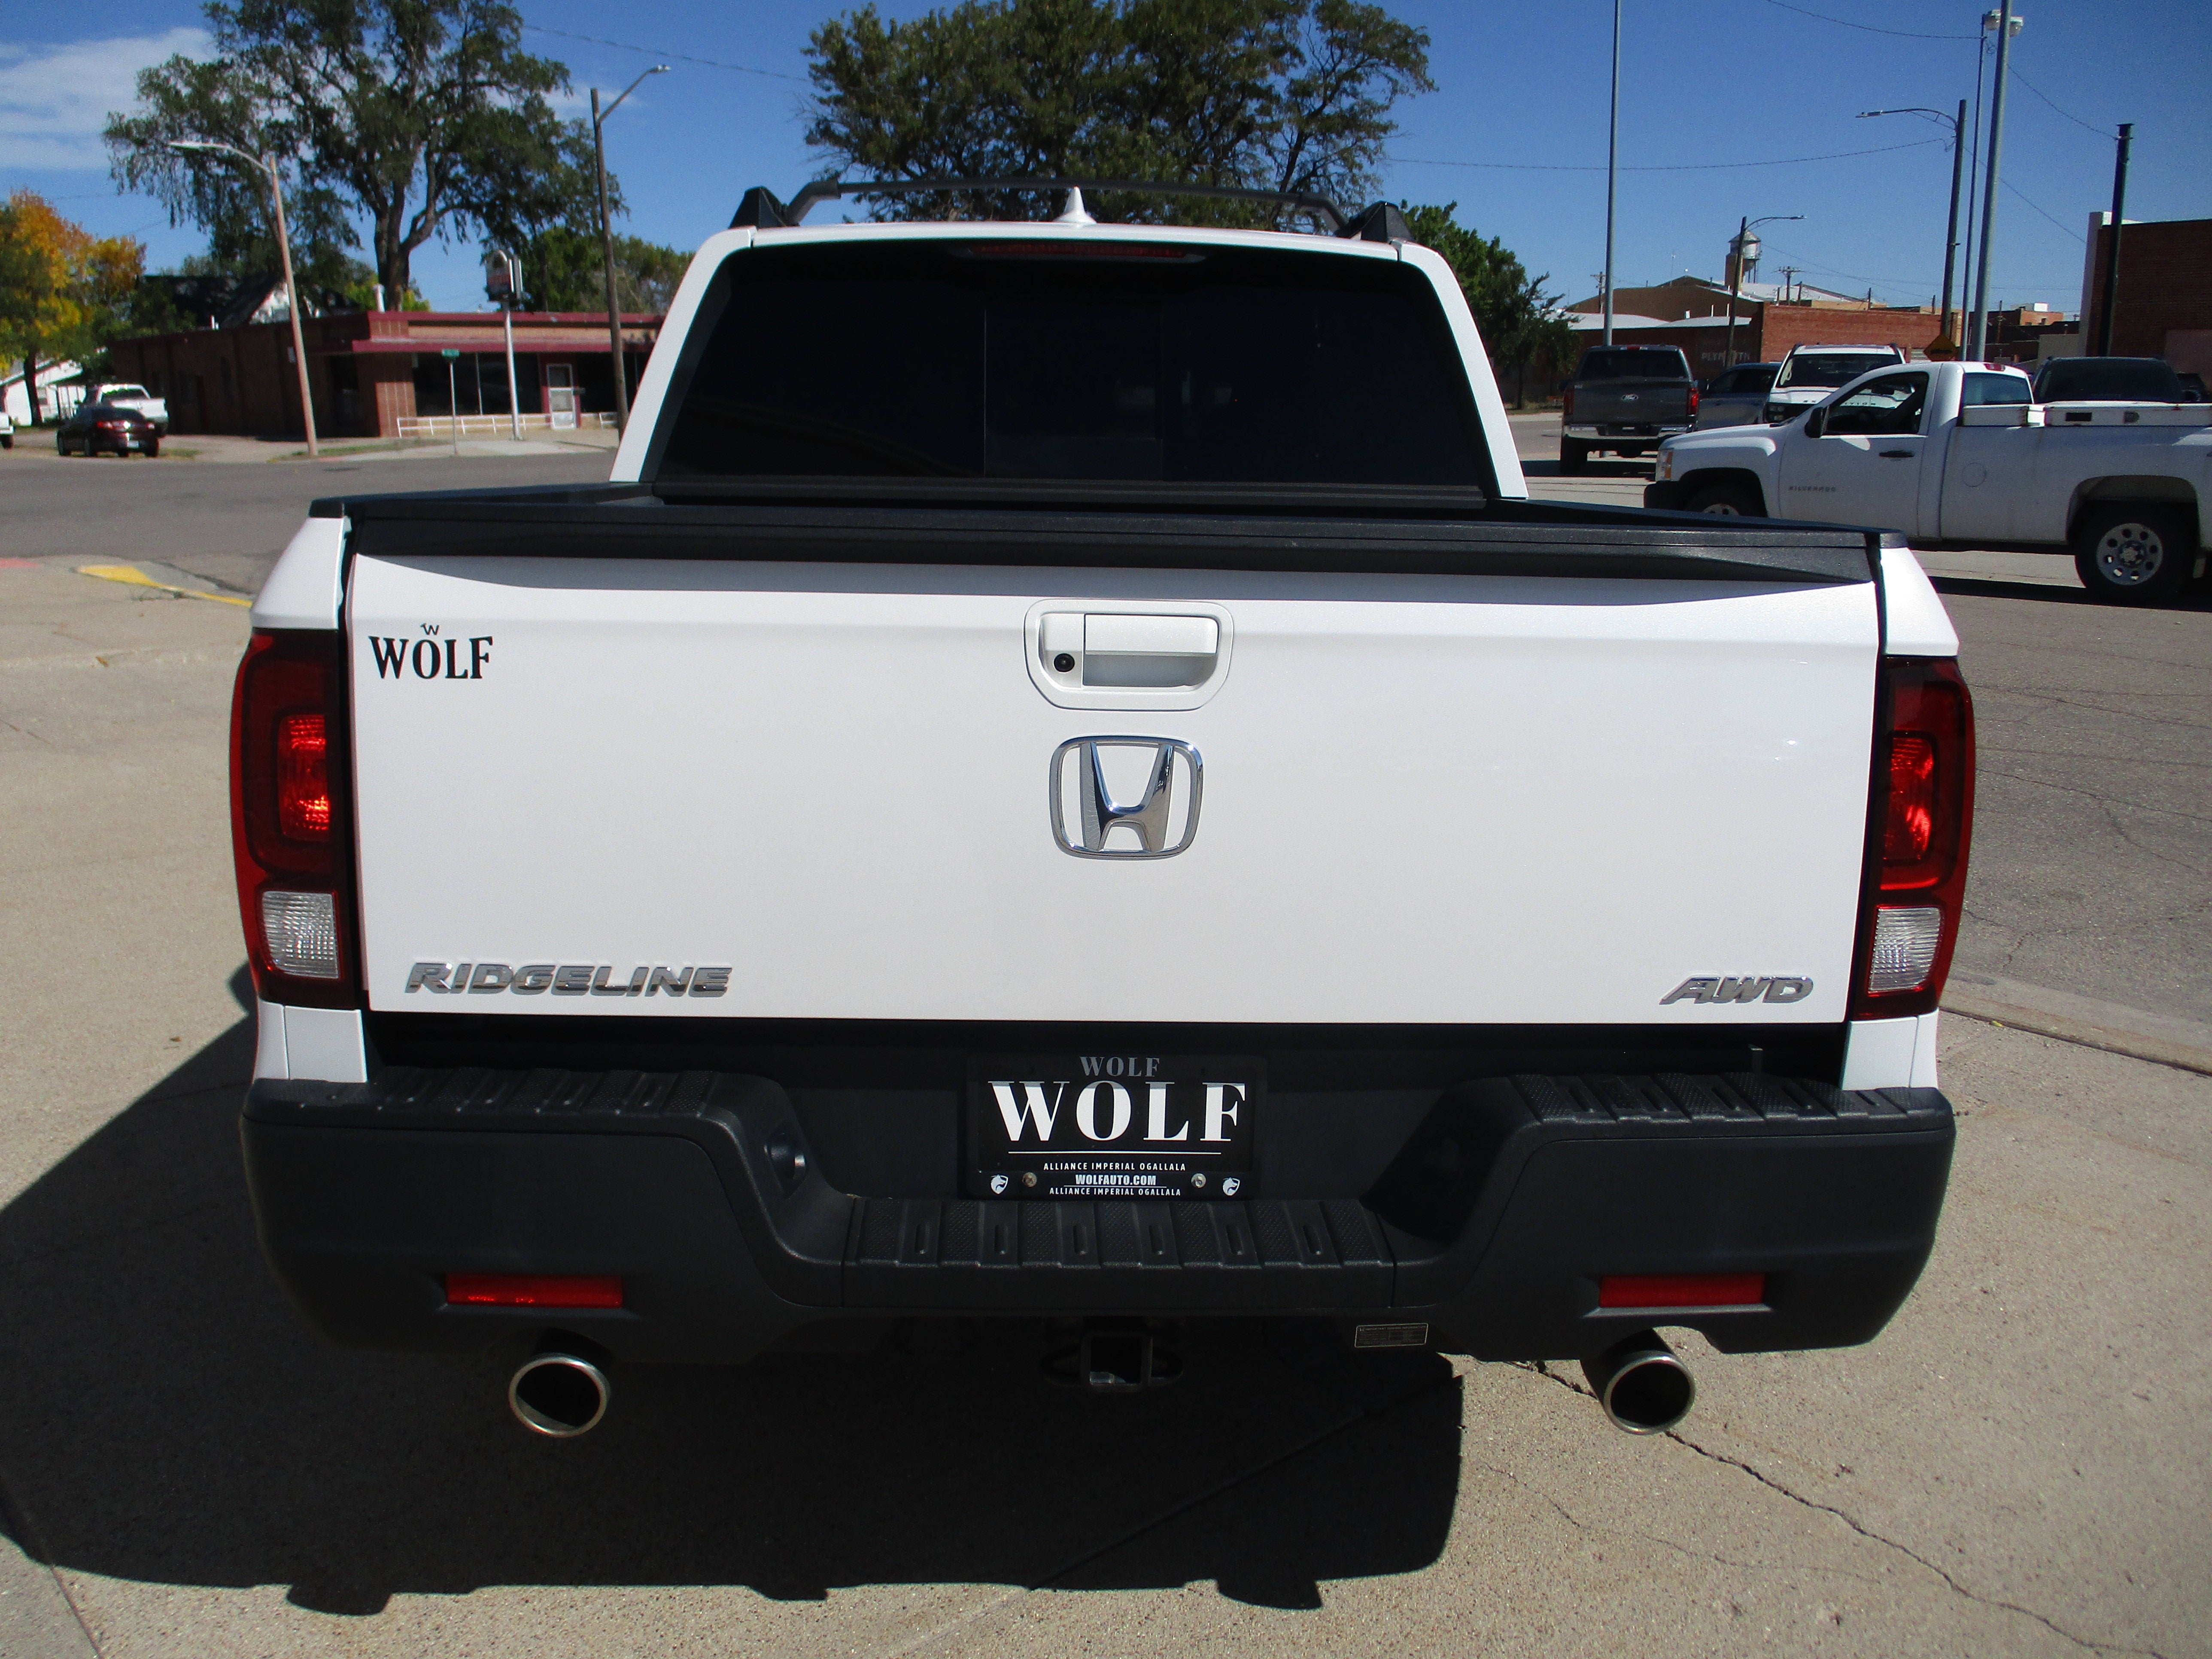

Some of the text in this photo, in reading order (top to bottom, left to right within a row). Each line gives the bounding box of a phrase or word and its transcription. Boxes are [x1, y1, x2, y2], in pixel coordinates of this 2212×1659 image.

[368, 636, 493, 679] WOLF
[404, 962, 733, 997] RIDGELINE
[1659, 975, 1814, 1005] AWD
[1079, 1056, 1160, 1077] WOLF
[987, 1080, 1245, 1142] WOLF
[1043, 1162, 1186, 1171] ALLIANCE IMPERIAL OGALLALA
[1075, 1174, 1157, 1185] WOLFAUTO.COM
